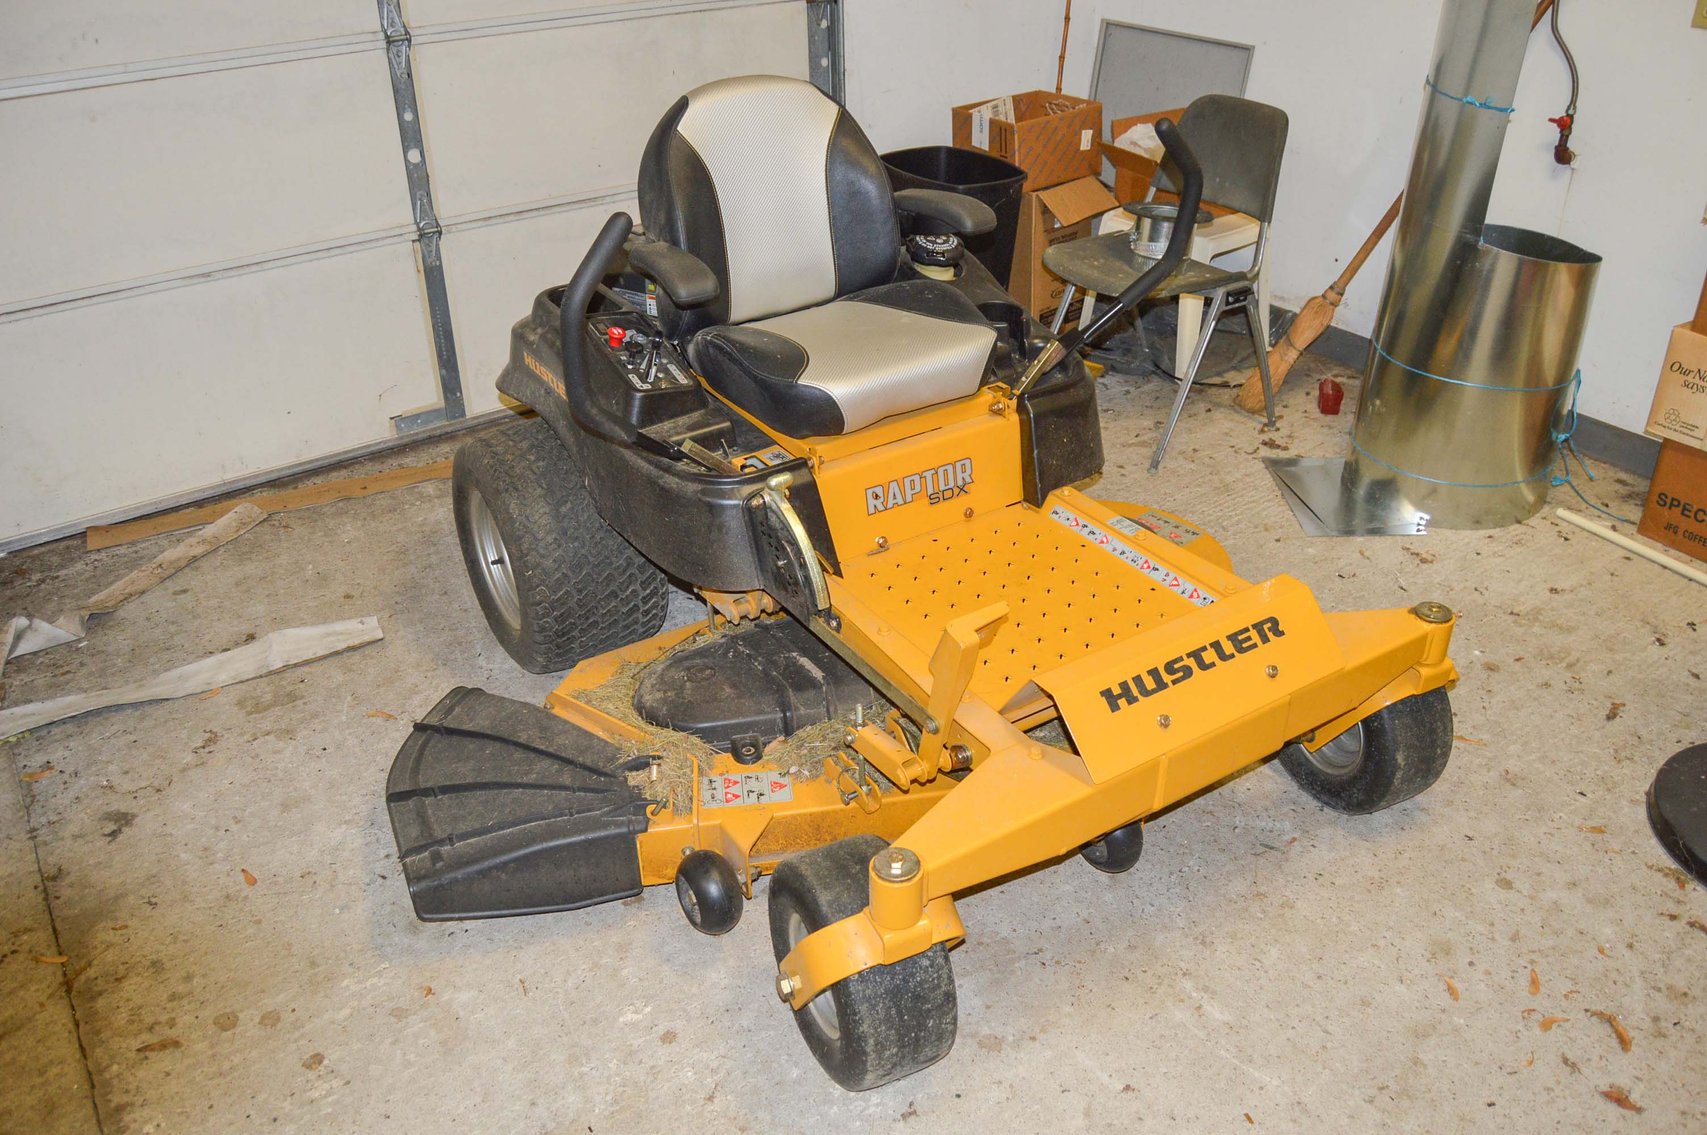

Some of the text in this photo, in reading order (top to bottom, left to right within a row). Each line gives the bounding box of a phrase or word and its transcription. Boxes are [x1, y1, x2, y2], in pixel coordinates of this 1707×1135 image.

[1670, 360, 1695, 377] Our
[865, 458, 974, 515] RAPTOR
[928, 482, 969, 505] SDX
[1656, 492, 1707, 523] SPEC
[1099, 616, 1286, 714] HUSTLER
